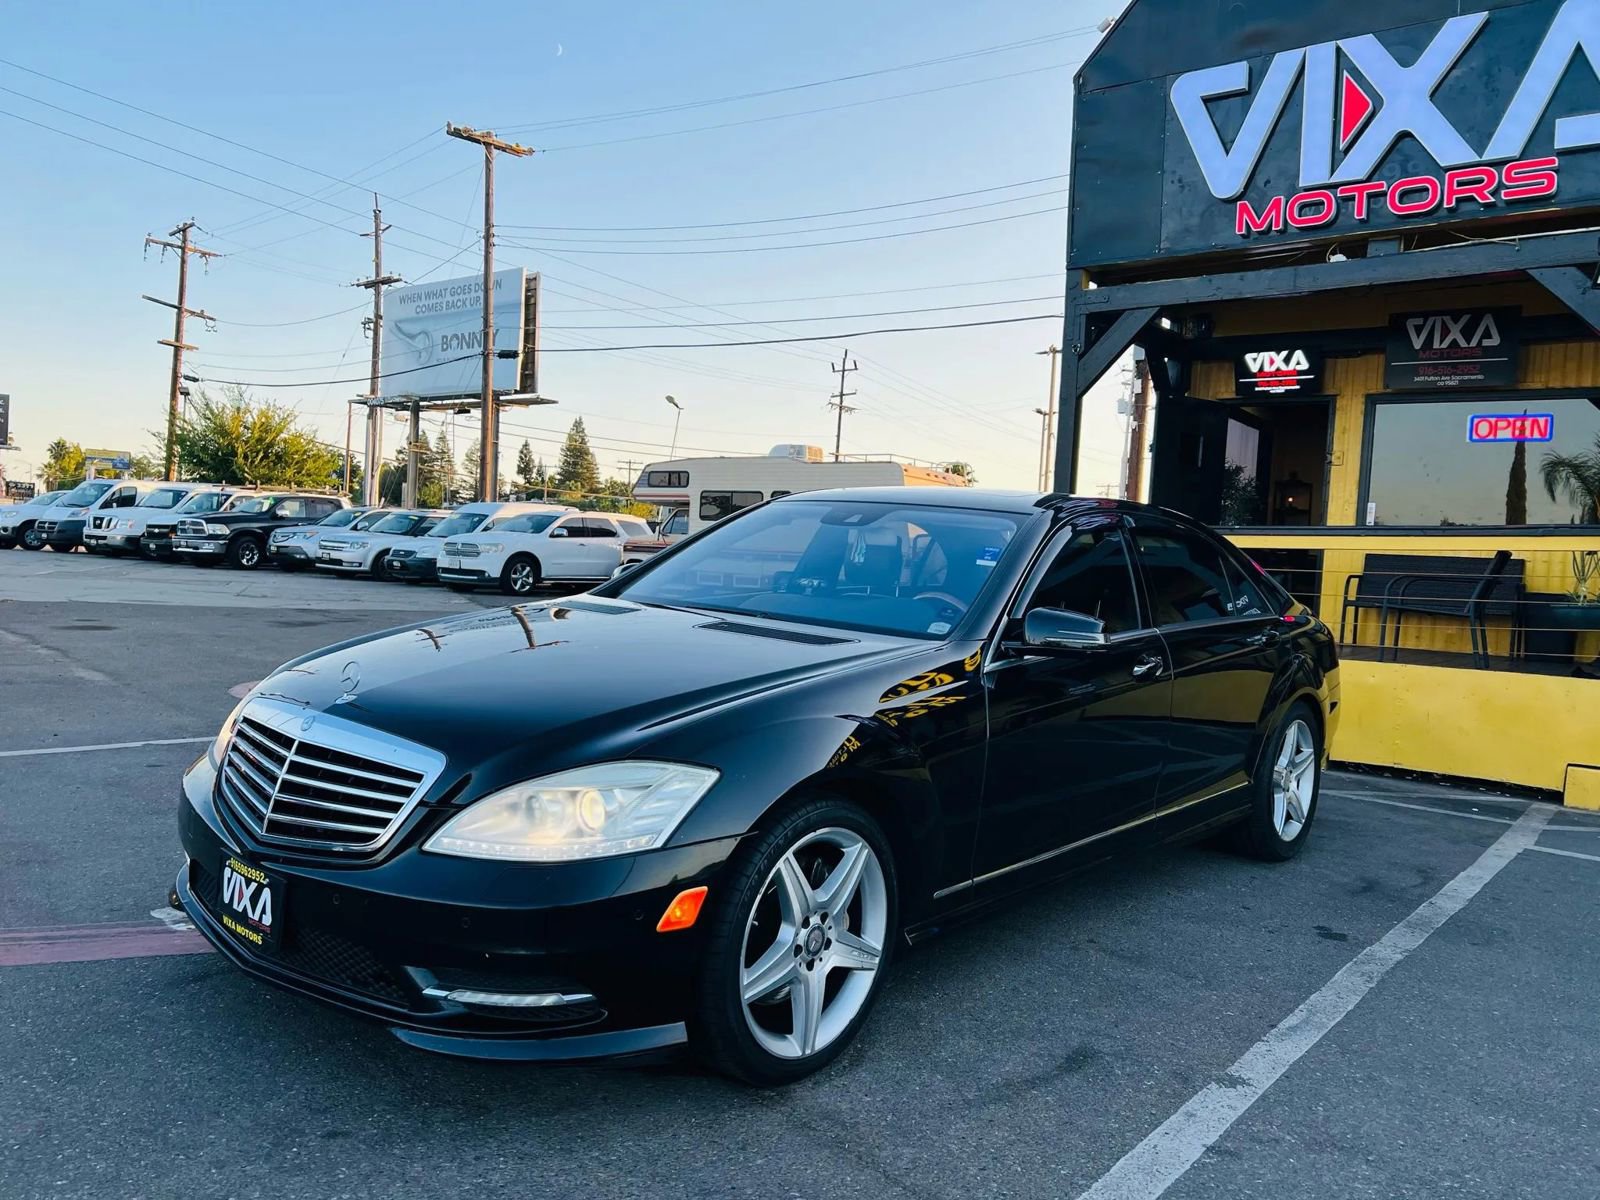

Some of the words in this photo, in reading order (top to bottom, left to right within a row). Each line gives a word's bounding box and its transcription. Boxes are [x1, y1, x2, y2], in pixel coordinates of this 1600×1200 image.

[1170, 0, 1600, 199] VIXA
[1235, 157, 1559, 235] MOTORS
[399, 292, 423, 305] WHEN
[424, 288, 449, 301] WHAT
[449, 283, 473, 297] GOES
[474, 279, 502, 293] DN
[415, 302, 445, 315] COMES
[445, 297, 468, 311] BACK
[1406, 313, 1501, 350] VIXA
[1244, 349, 1310, 373] VIXA
[1418, 347, 1482, 358] MOTORS
[1473, 416, 1549, 439] OPEN
[223, 866, 273, 927] VIXA
[222, 914, 236, 931] VIXA
[236, 924, 263, 945] MOTORS
